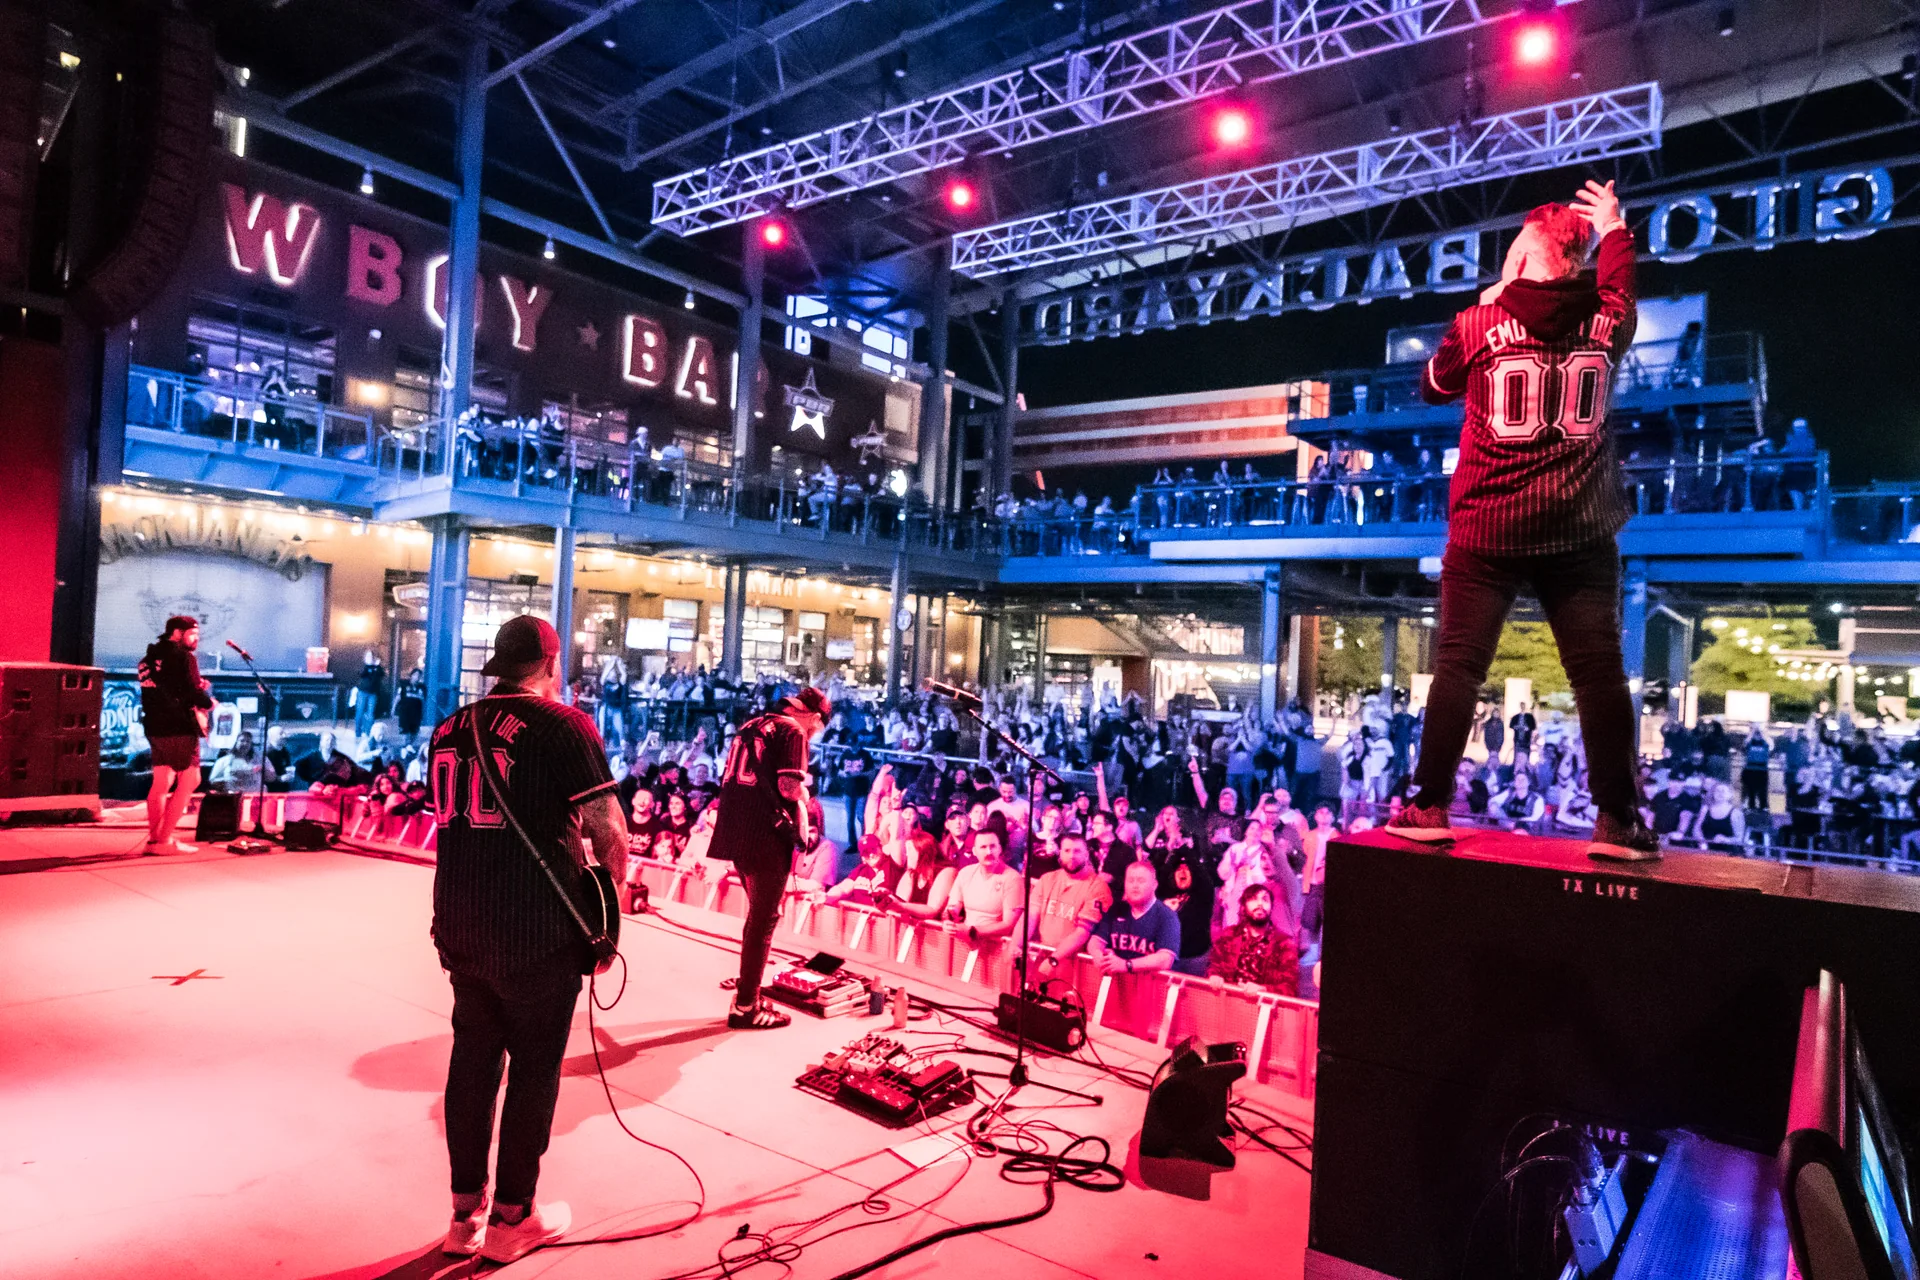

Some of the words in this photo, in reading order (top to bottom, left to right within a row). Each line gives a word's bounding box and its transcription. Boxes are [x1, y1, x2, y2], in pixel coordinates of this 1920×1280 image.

[1589, 313, 1620, 348] DIE
[1484, 351, 1615, 442] 00
[496, 713, 527, 744] DIE
[1563, 879, 1583, 893] TX
[1595, 882, 1639, 900] LIVE
[1046, 900, 1075, 921] EXA
[1586, 1124, 1630, 1146] LIVE
